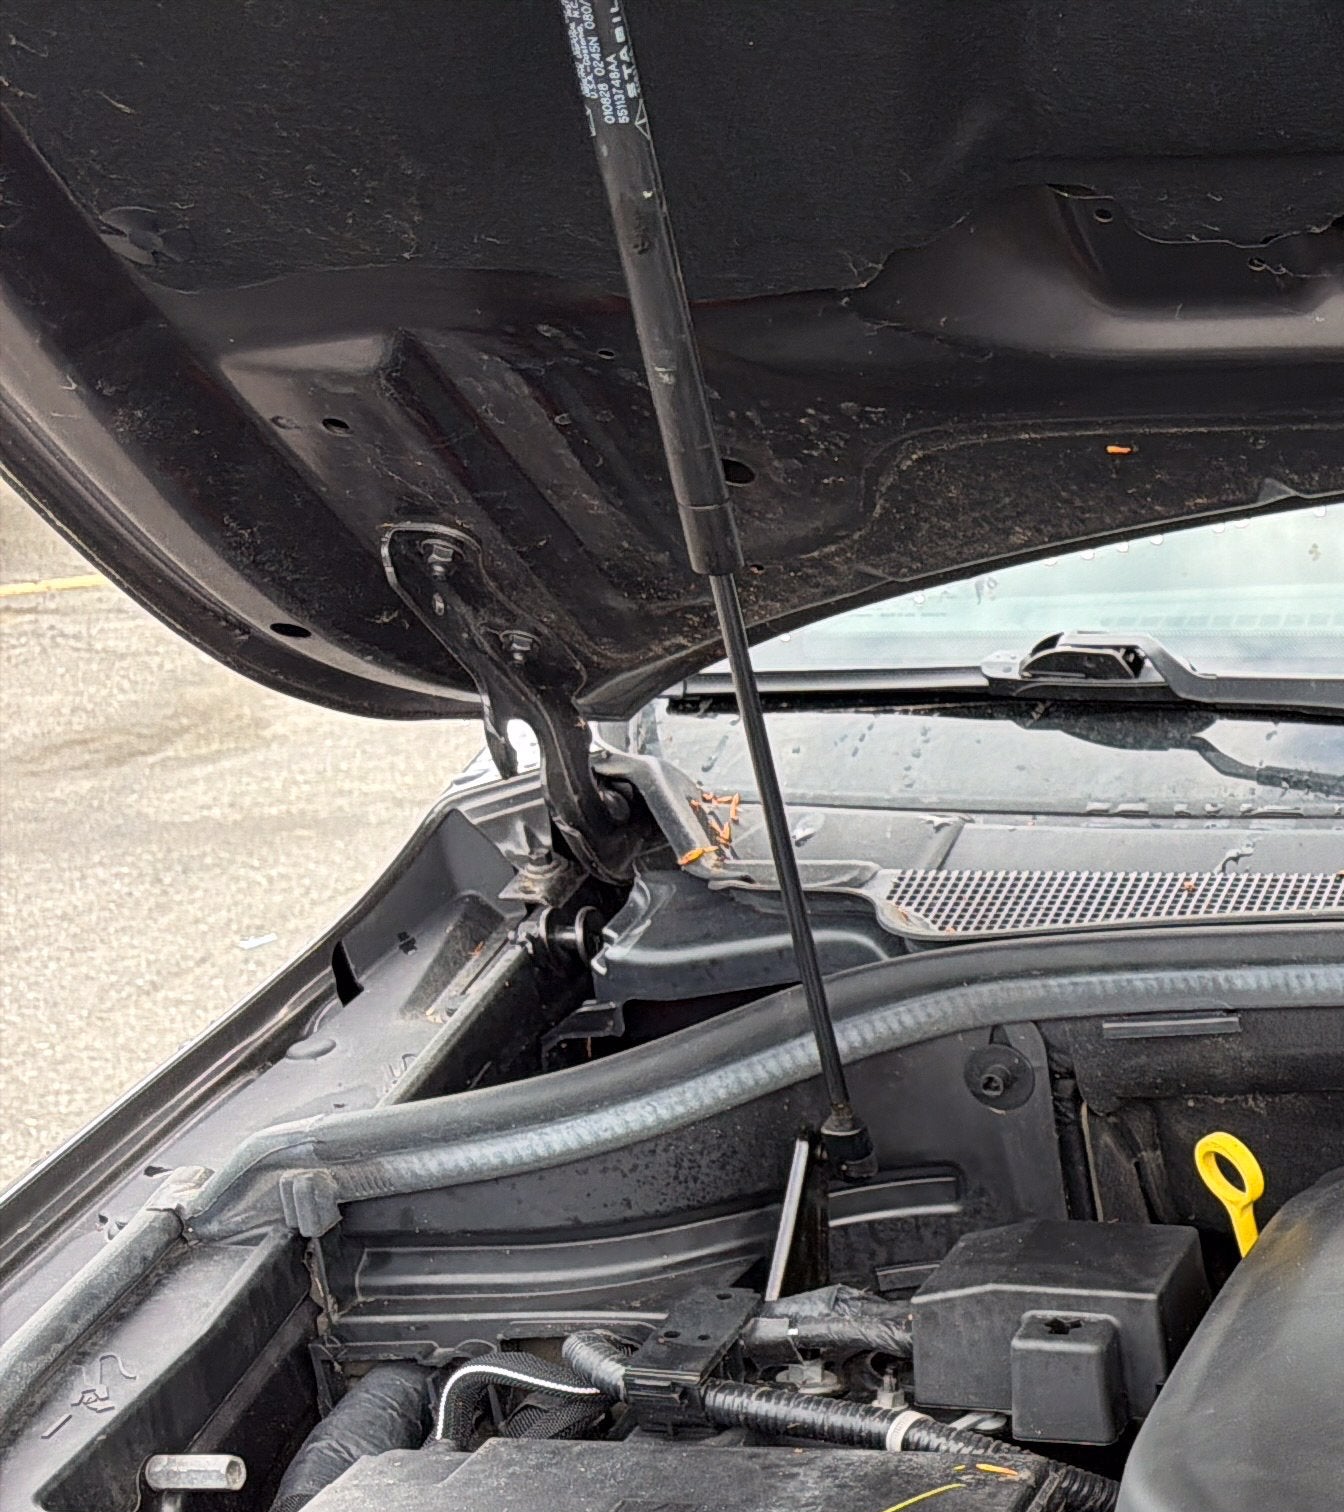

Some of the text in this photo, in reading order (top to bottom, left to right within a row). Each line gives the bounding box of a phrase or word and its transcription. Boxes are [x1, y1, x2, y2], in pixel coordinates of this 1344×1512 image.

[587, 37, 605, 76] 0245N
[598, 83, 615, 124] 010828
[606, 54, 630, 124] 55113748AA
